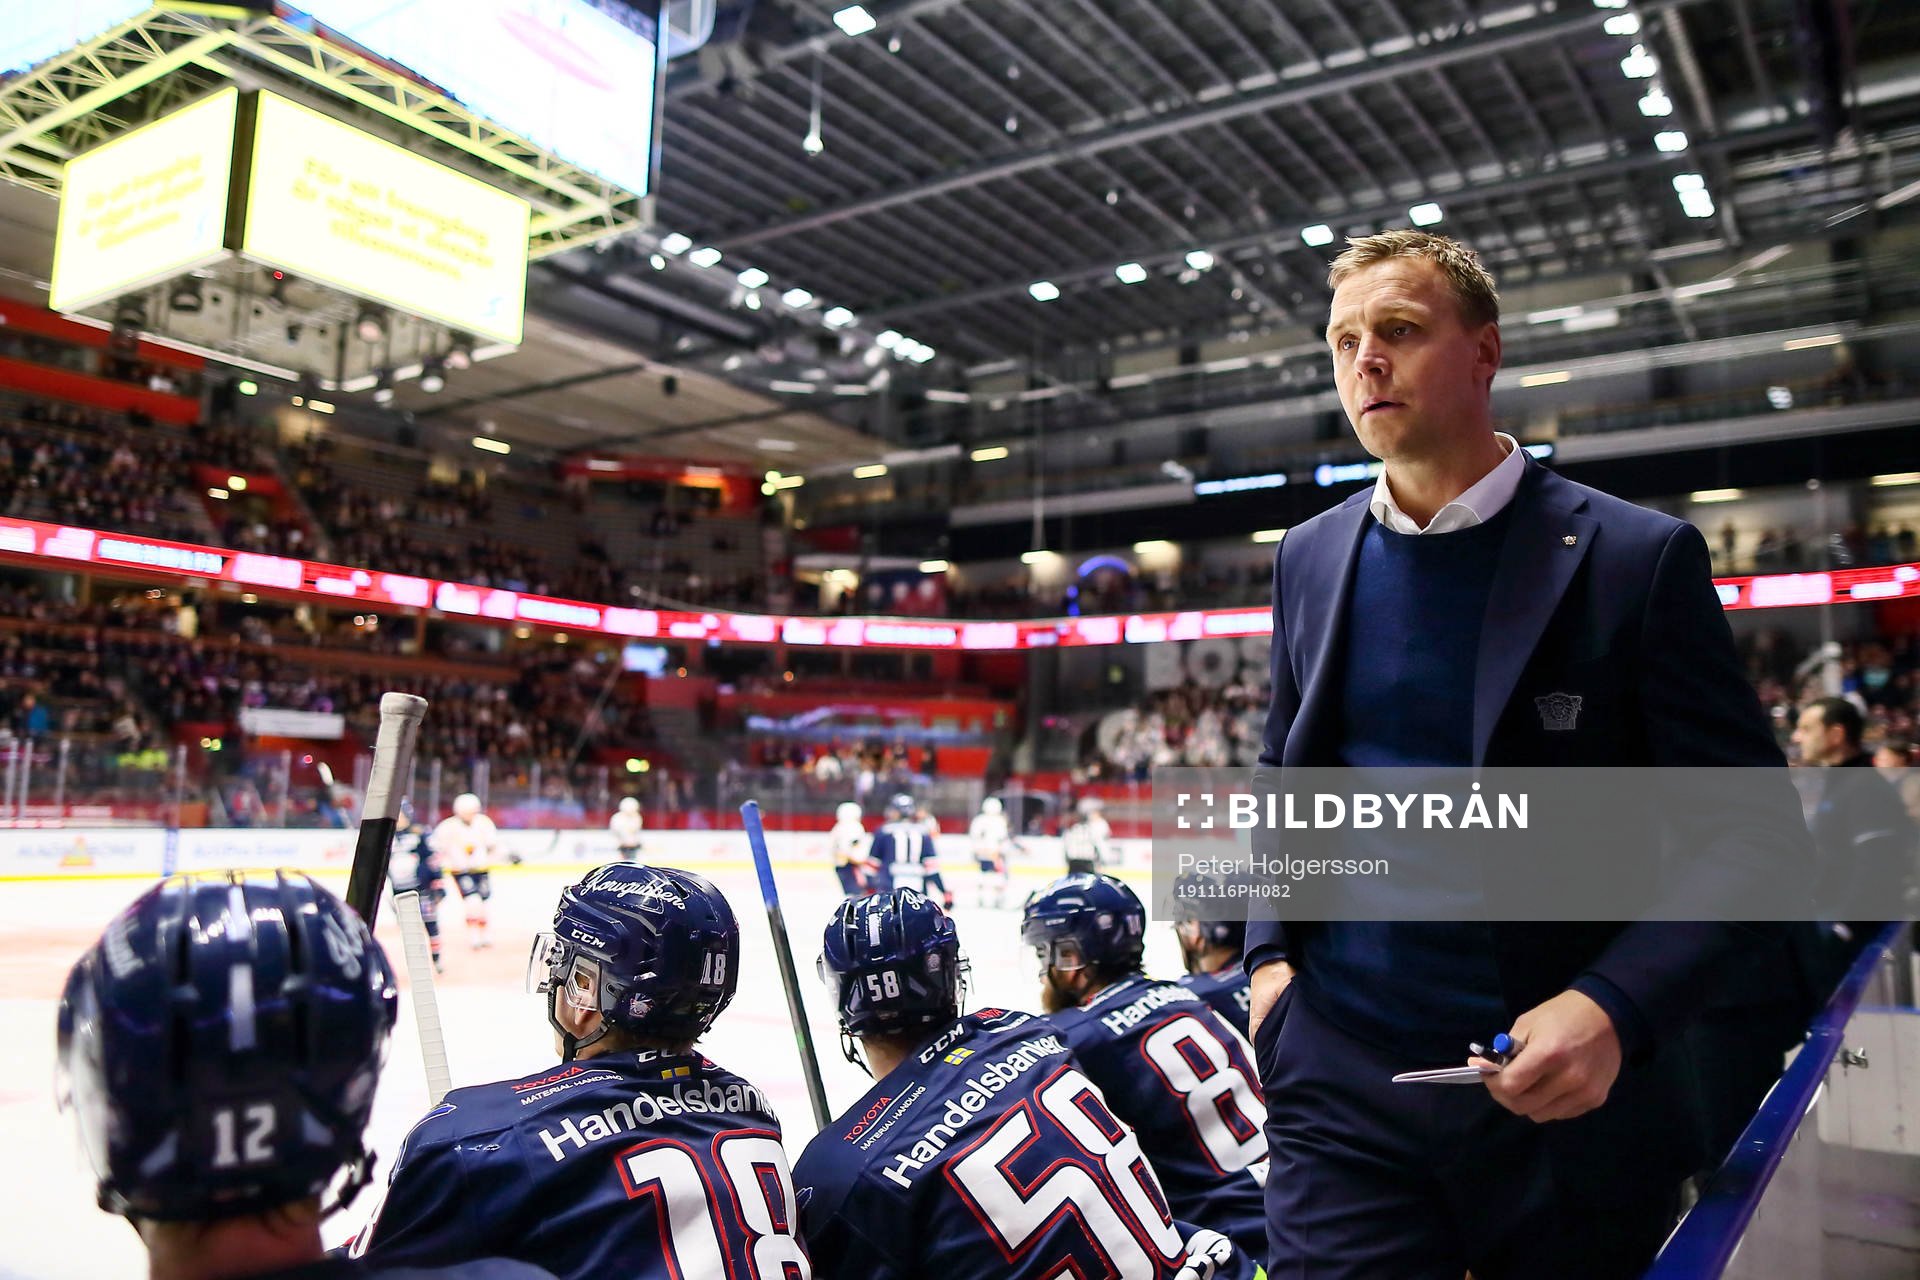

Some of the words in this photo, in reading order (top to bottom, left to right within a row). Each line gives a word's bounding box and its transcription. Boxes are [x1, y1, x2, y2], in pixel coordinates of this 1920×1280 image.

[571, 929, 606, 948] CCM
[700, 953, 727, 985] 18
[866, 970, 901, 1002] 58
[919, 1023, 964, 1064] CCM
[511, 1066, 584, 1091] TOYOTA
[521, 1083, 574, 1106] MATERIAL
[573, 1074, 624, 1087] HANDLING
[1140, 1012, 1268, 1177] 8
[844, 1096, 892, 1140] TOYOTA
[860, 1120, 896, 1151] MATERIAL
[892, 1086, 927, 1120] HANDLING
[882, 1035, 1069, 1189] Handelsbanken
[212, 1103, 277, 1167] 12
[942, 1063, 1190, 1280] 58
[614, 1127, 812, 1280] 18
